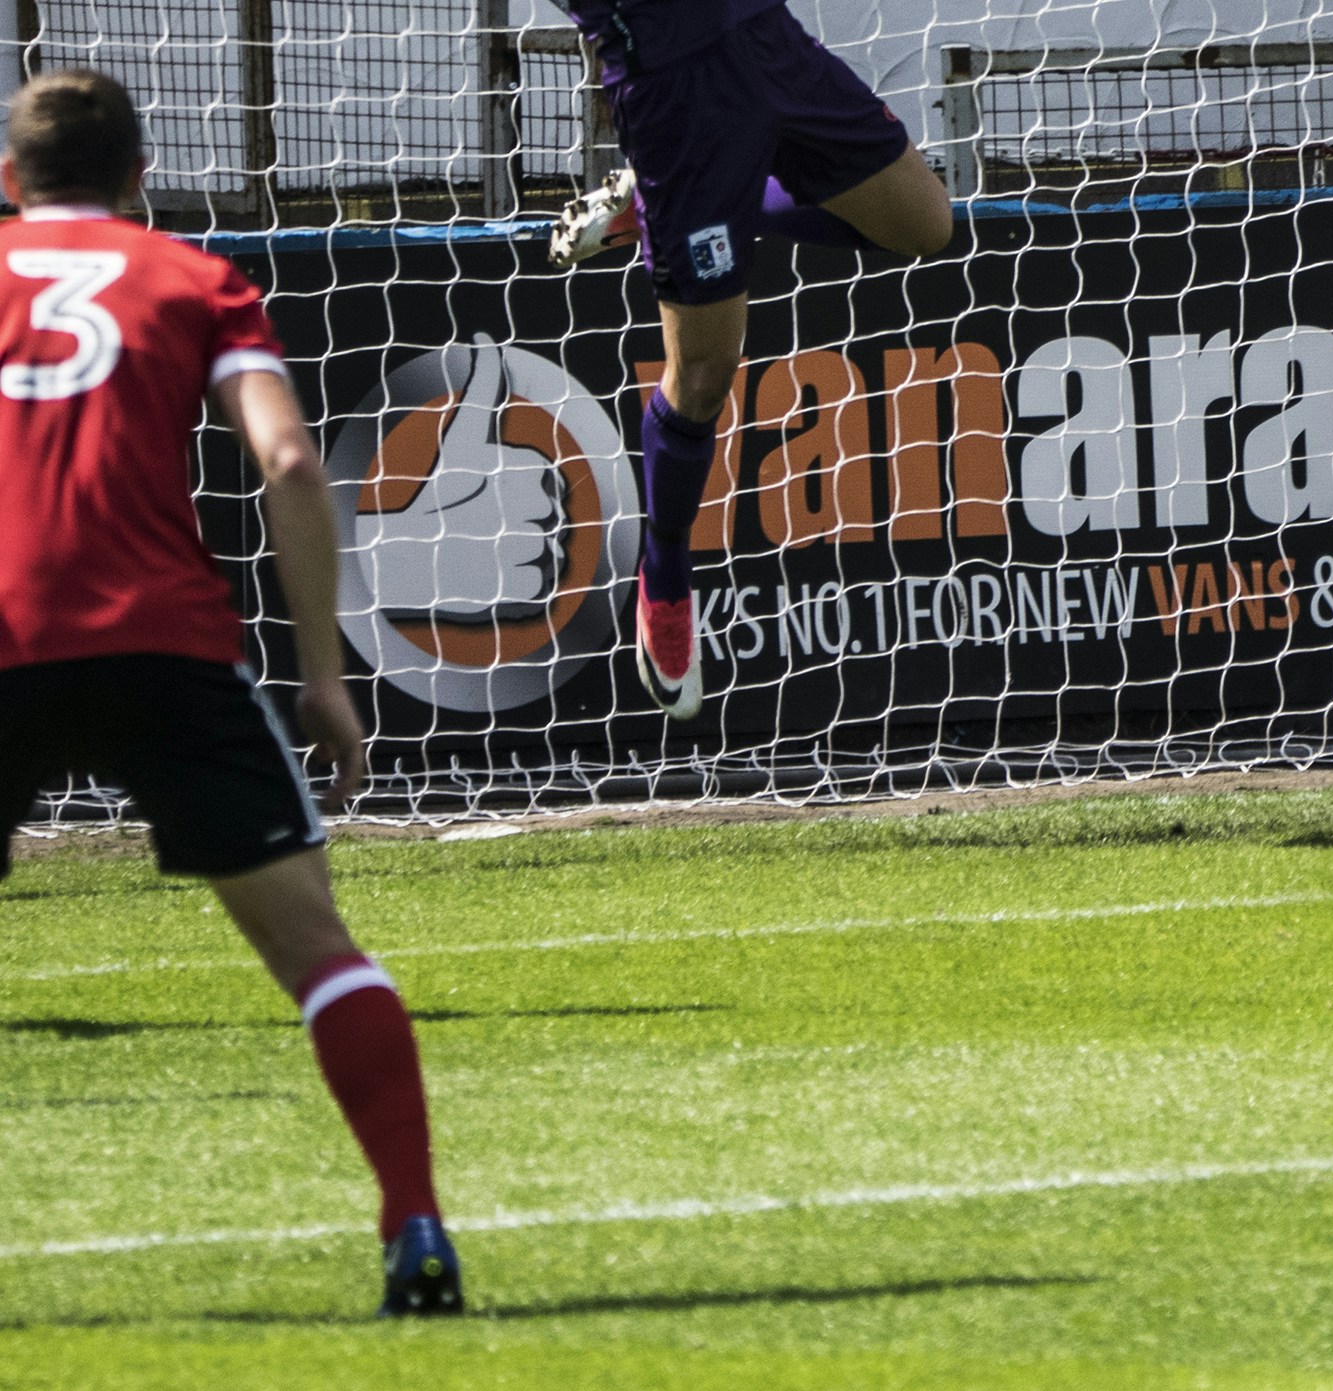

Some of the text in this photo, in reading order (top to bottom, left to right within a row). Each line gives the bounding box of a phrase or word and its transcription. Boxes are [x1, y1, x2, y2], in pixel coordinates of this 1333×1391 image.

[0, 249, 127, 400] 3
[905, 573, 1004, 650] FOR
[1017, 567, 1139, 645] NEW
[1148, 558, 1300, 636] VANS
